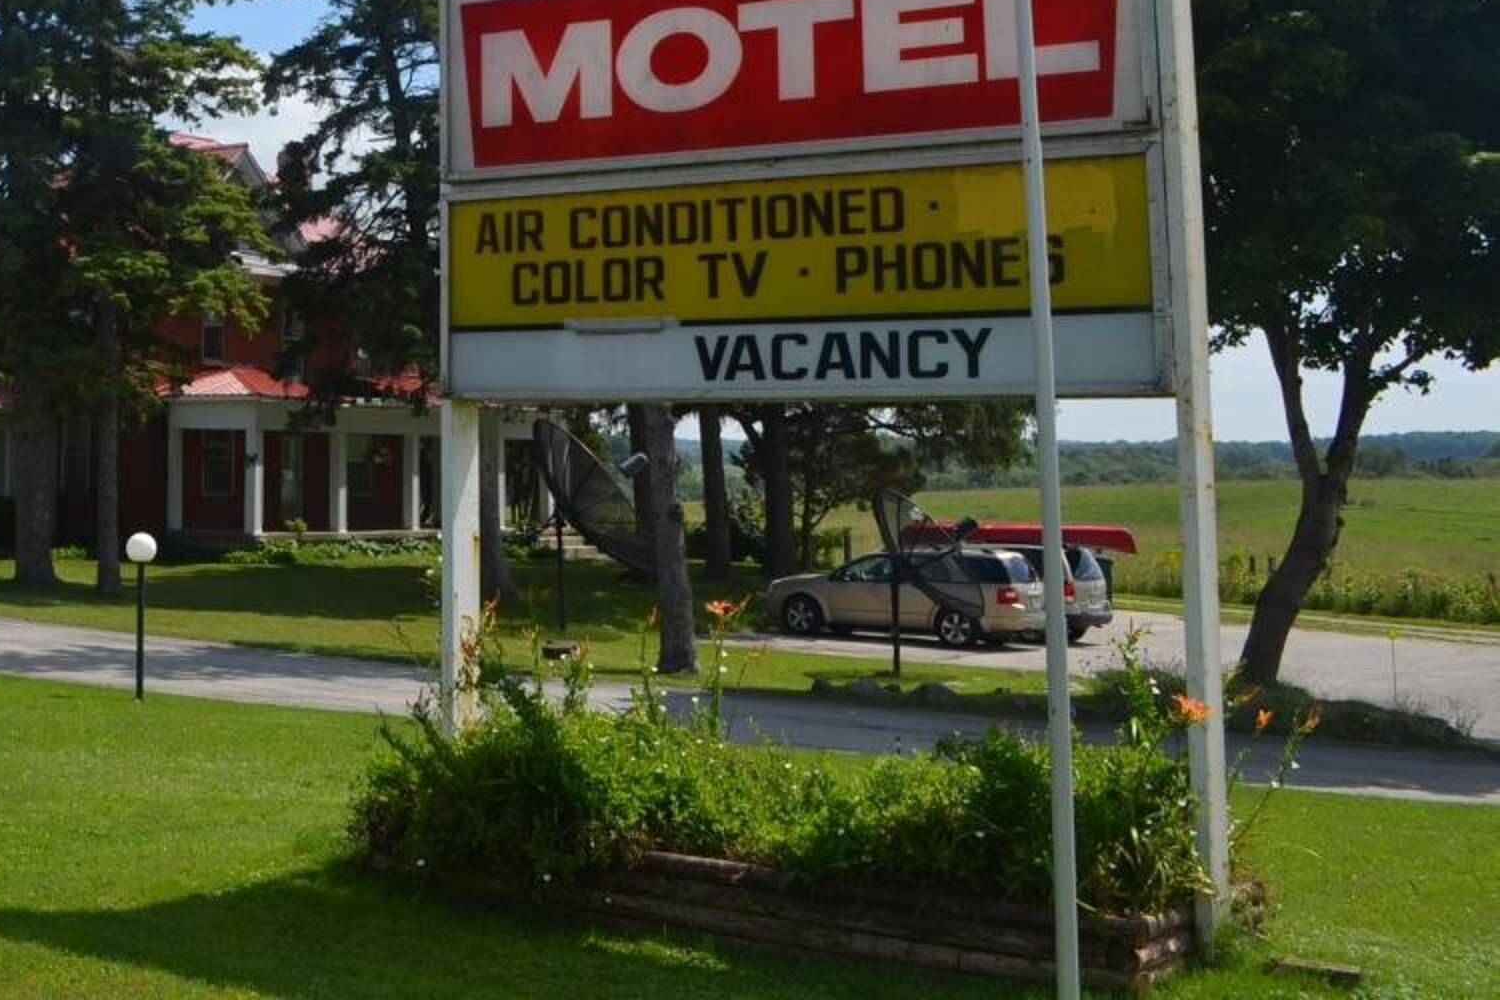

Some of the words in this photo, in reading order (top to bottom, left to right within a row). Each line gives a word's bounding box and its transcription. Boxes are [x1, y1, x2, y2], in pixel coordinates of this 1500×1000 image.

[476, 211, 543, 254] AIR
[569, 187, 905, 250] CONDITIONED
[512, 256, 665, 306] COLOR
[698, 250, 768, 299] TV
[694, 329, 993, 381] VACANCY
